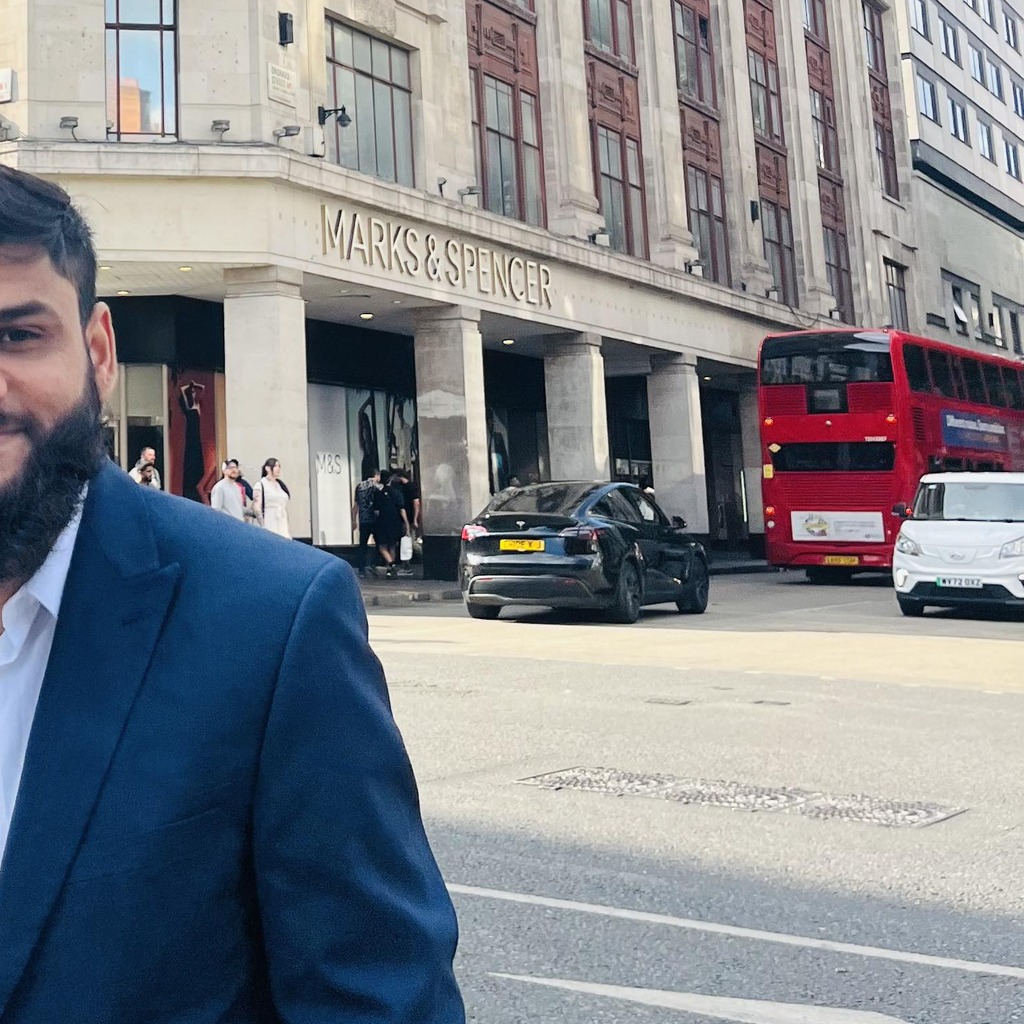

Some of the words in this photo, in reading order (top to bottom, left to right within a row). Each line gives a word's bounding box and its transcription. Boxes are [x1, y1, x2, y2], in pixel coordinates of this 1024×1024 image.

[321, 204, 419, 277] MARKS
[425, 233, 442, 282] &
[445, 238, 553, 310] SPENCER
[316, 453, 342, 475] M&S
